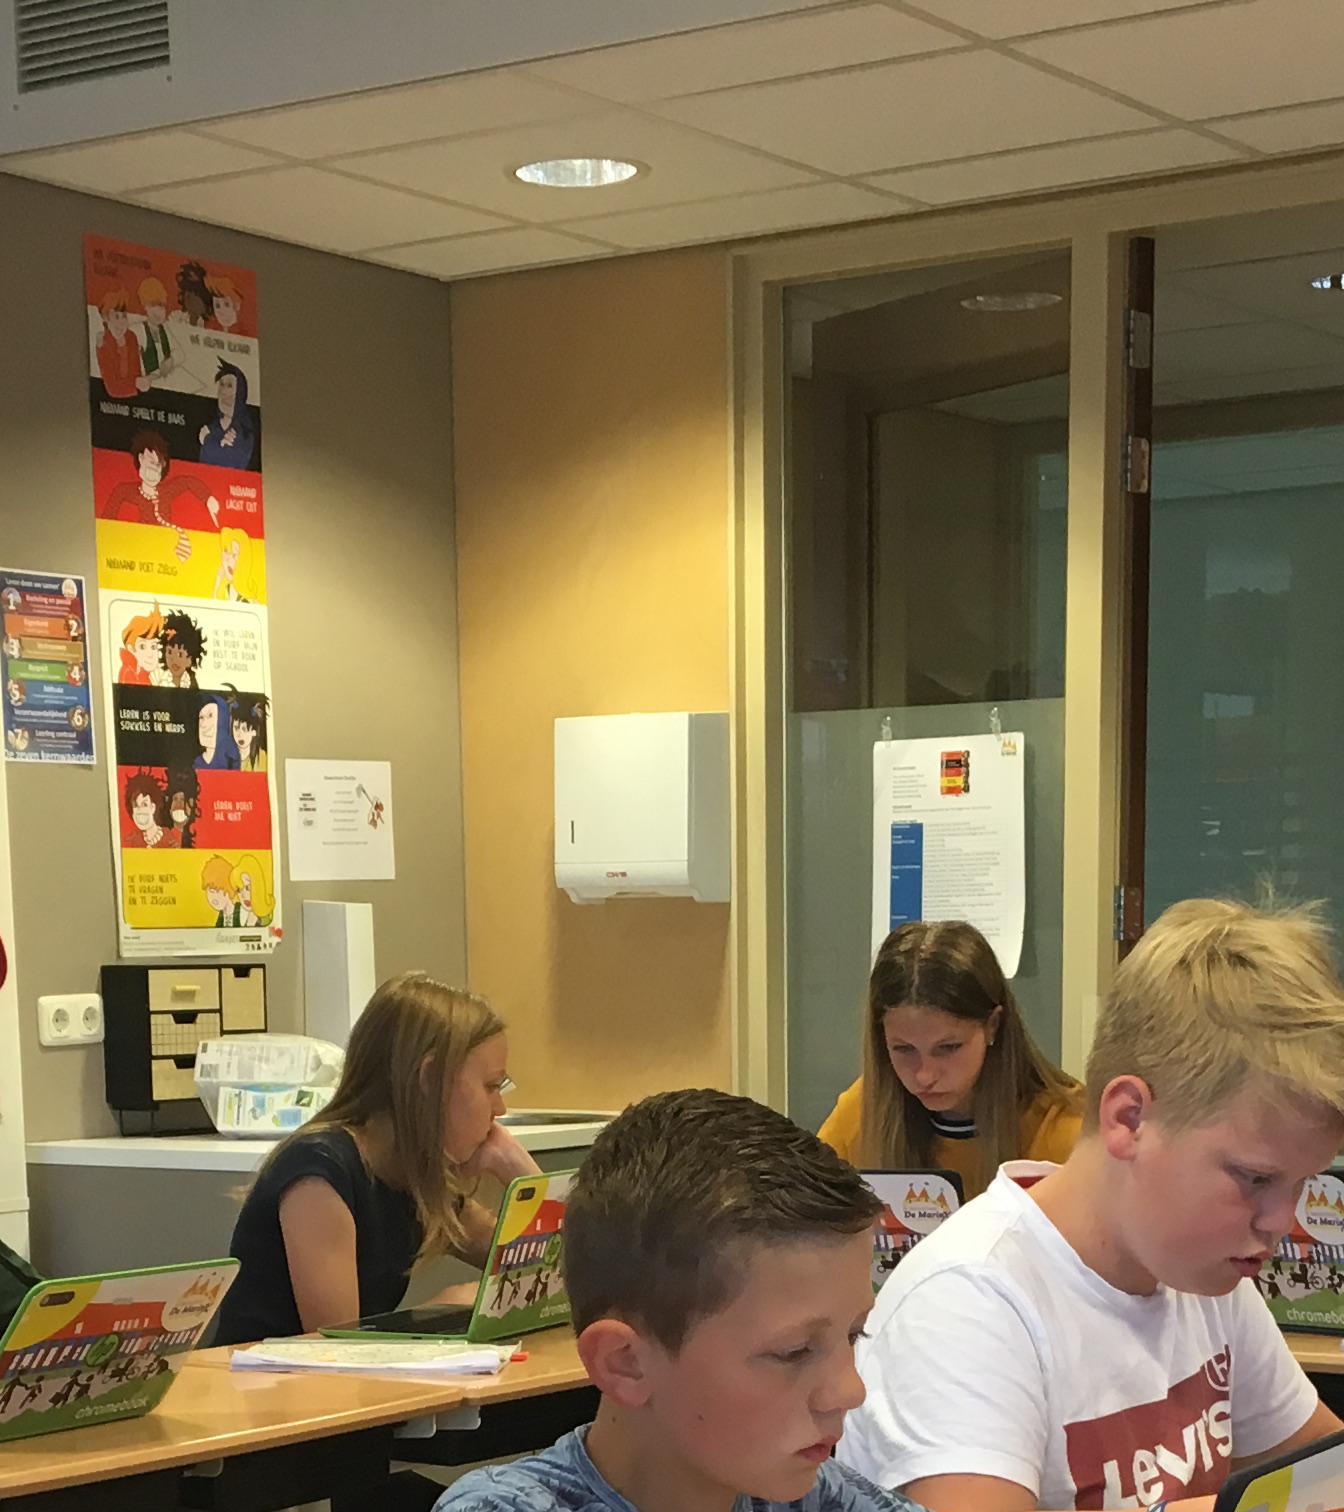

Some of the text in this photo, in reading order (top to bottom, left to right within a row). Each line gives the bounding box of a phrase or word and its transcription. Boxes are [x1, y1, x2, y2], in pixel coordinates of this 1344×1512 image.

[99, 401, 186, 426] NIEMAND SPEELT DE BAAS
[229, 484, 258, 499] NIEMAND
[225, 500, 259, 513] LACHT UIT
[106, 557, 179, 577] NIEMAND DOET ZIELIG
[7, 593, 16, 610] 1
[69, 620, 79, 636] 2
[70, 665, 80, 679] 4
[225, 661, 249, 673] SCHOOL
[12, 684, 20, 701] 5
[74, 709, 83, 726] 6
[119, 708, 170, 722] LEREN IS VOOR
[154, 722, 162, 733] EN
[165, 723, 186, 734] NERDS
[213, 800, 233, 811] LEREN
[227, 812, 242, 822] NIET
[128, 874, 178, 884] IK DURF NIETS
[138, 885, 164, 894] VRAGEN
[128, 896, 137, 905] EN
[150, 896, 177, 905] ZEGGEN
